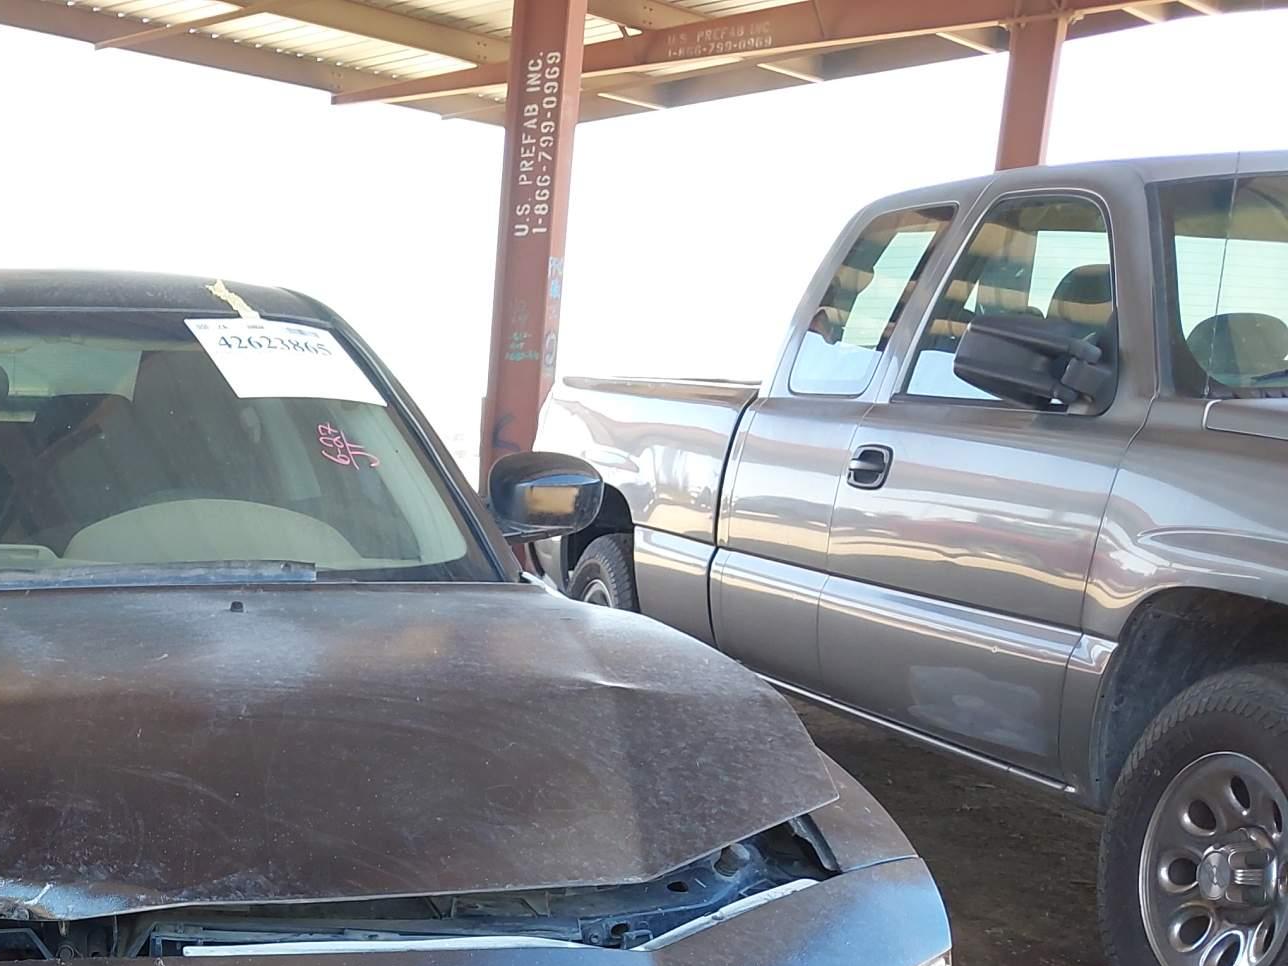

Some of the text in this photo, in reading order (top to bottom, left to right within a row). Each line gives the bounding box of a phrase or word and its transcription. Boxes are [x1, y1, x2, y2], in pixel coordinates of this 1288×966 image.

[514, 51, 544, 237] U.S. PREFAB INC.
[532, 51, 562, 234] 1-866-799-0969
[217, 335, 333, 357] 42623865
